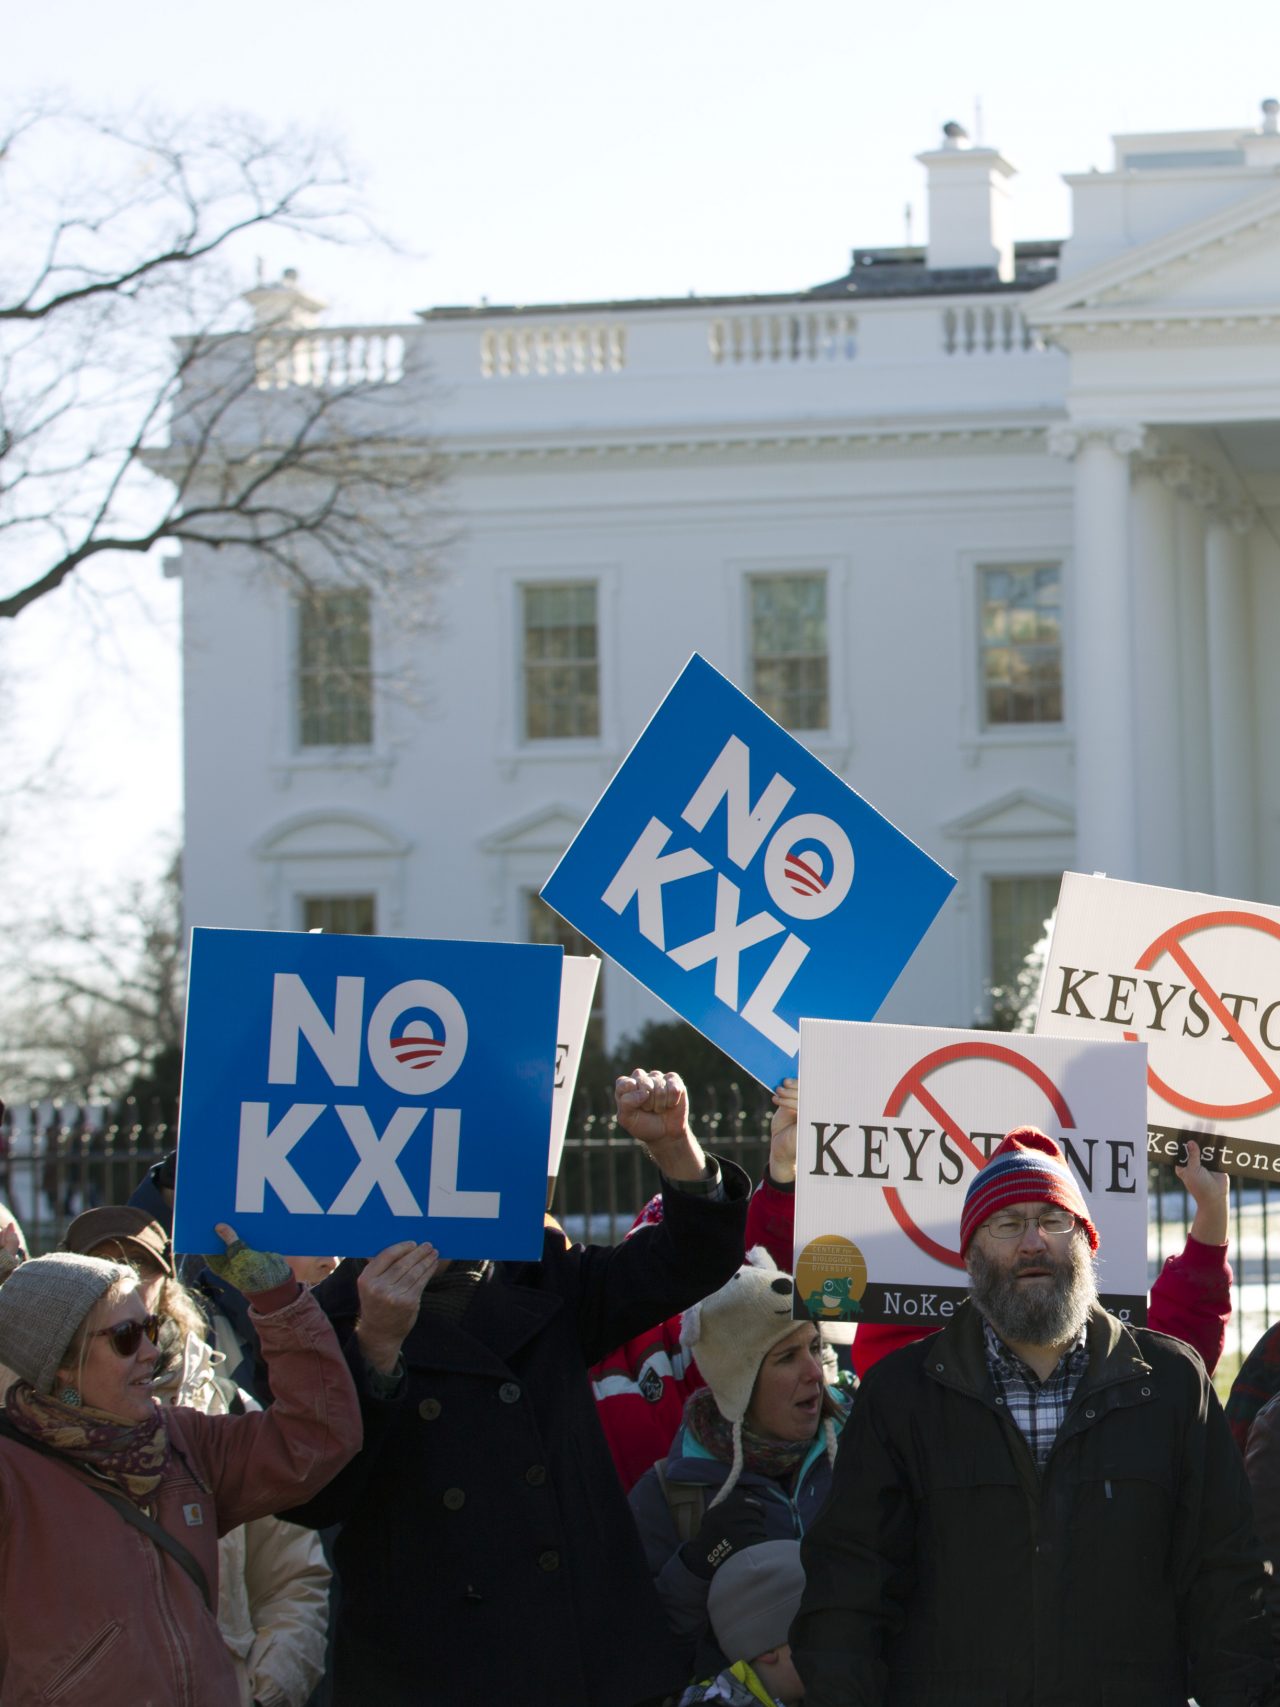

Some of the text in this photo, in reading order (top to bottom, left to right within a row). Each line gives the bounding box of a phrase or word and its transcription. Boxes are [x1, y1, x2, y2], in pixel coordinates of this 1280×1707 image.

[681, 734, 855, 920] NO
[601, 816, 810, 1058] KXL
[268, 973, 468, 1095] NO
[235, 1101, 500, 1218] KXL
[809, 1122, 1136, 1193] KEYSTNE
[707, 1538, 730, 1563] GORE
